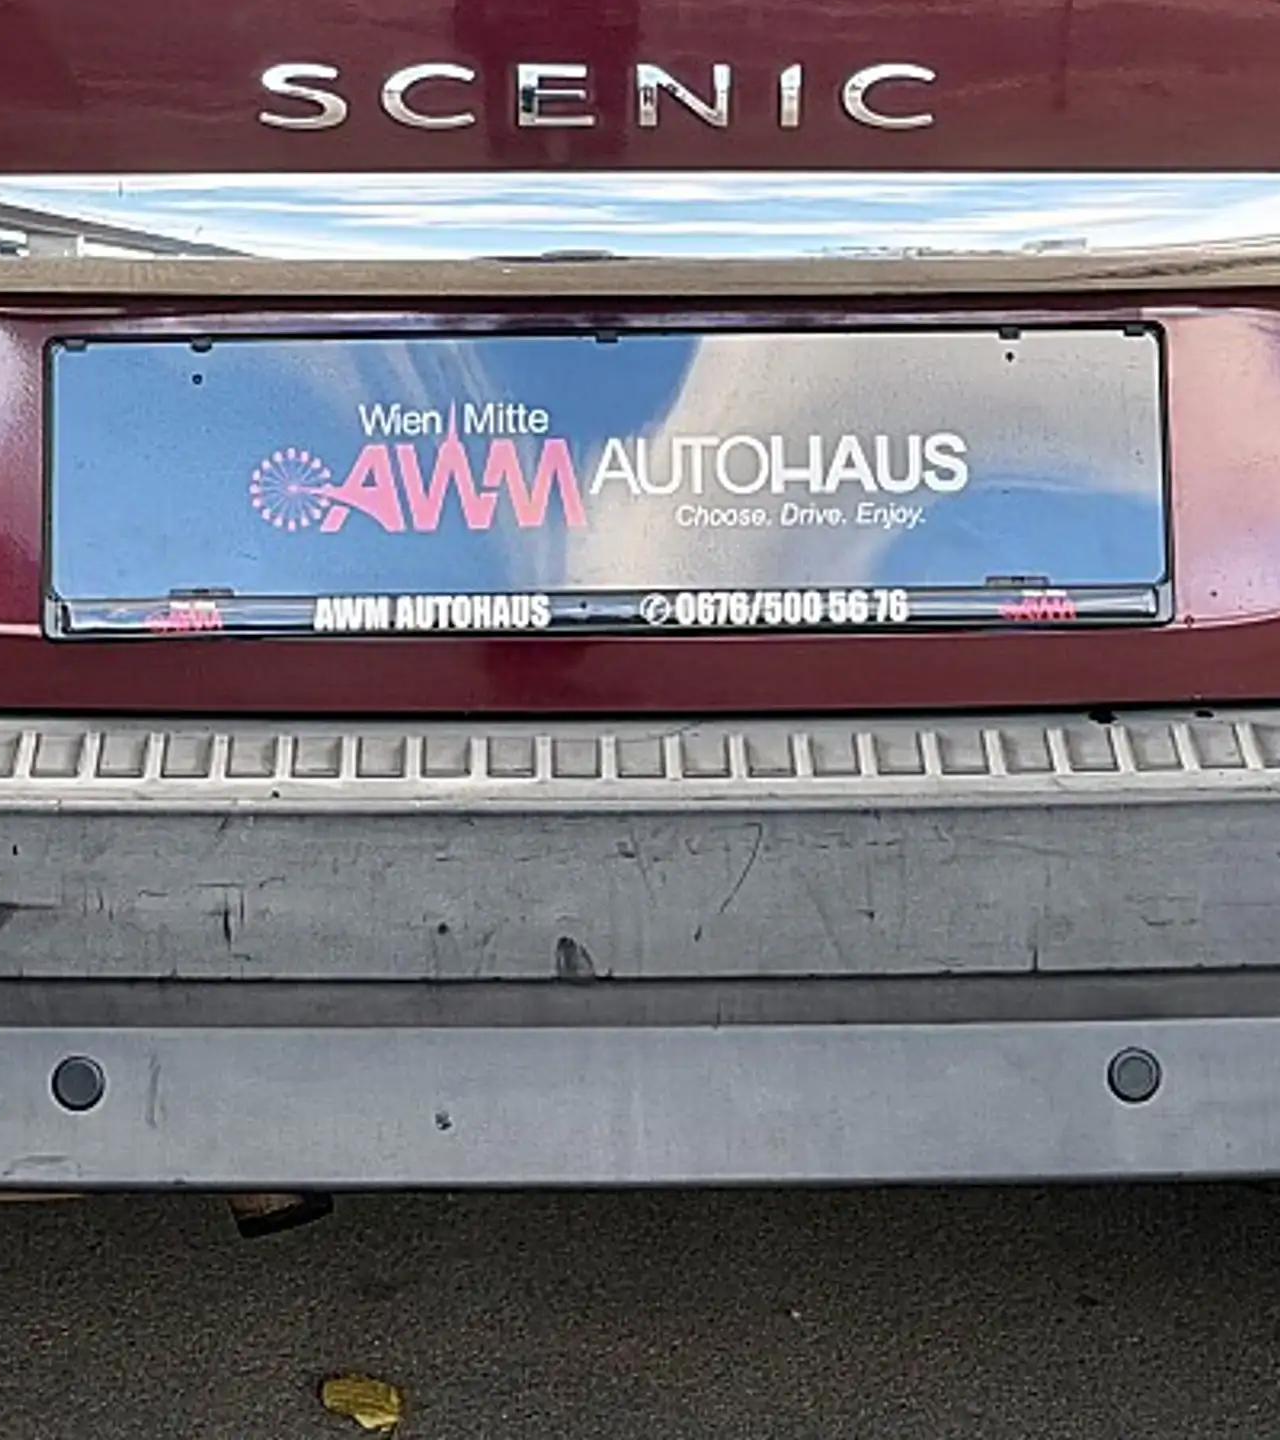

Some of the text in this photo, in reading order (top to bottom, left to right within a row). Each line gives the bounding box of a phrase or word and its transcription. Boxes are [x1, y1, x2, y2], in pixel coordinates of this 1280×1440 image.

[258, 62, 938, 131] SCENIC
[358, 402, 550, 437] Wien Mitte
[320, 432, 969, 533] AWM AUTOHAUS
[675, 500, 927, 531] Choose. Drive. Enjoy.
[313, 593, 552, 631] AWM AUTOHAUS
[675, 590, 822, 625] 0676/500
